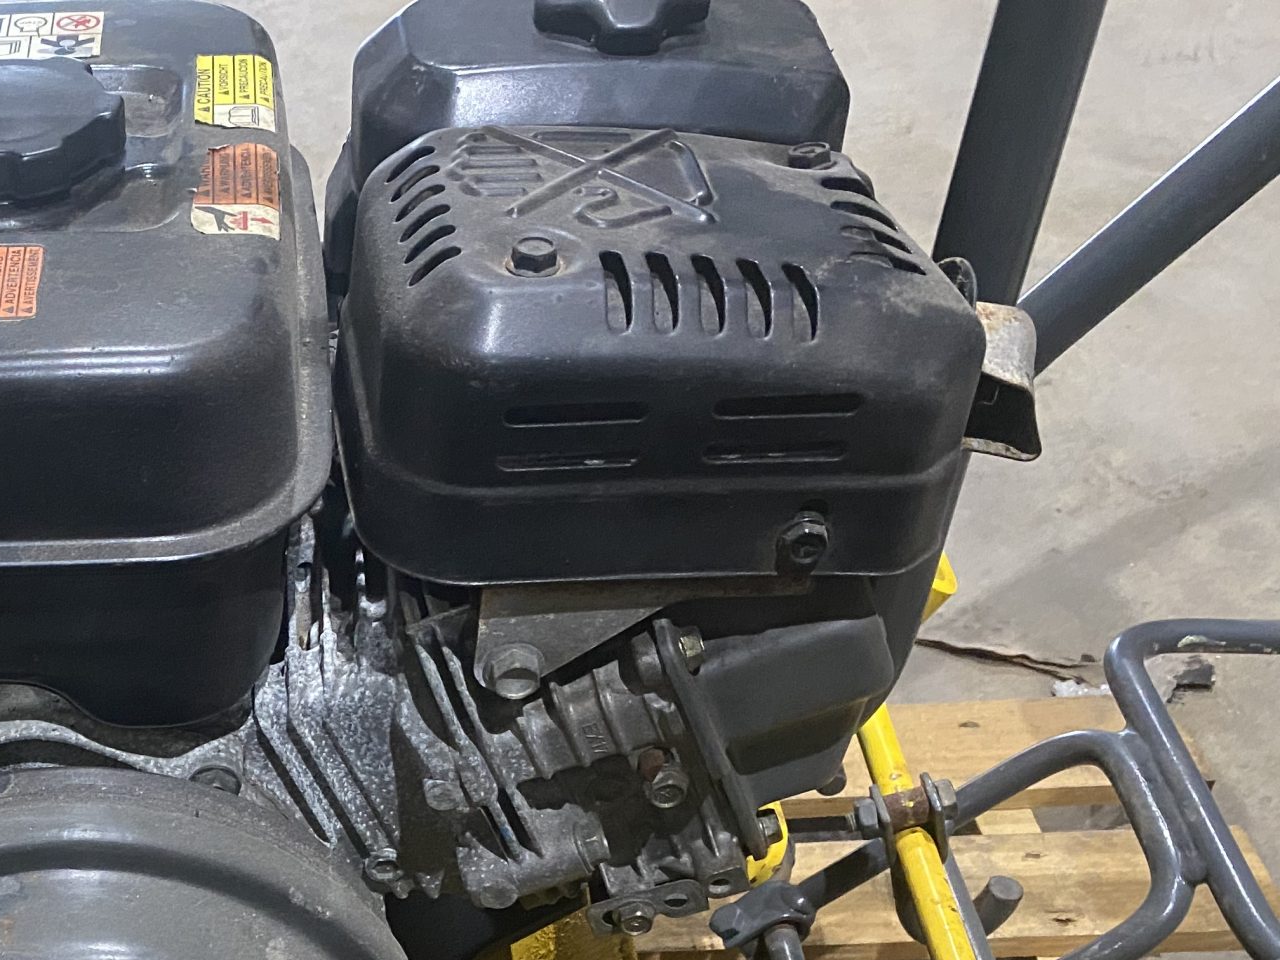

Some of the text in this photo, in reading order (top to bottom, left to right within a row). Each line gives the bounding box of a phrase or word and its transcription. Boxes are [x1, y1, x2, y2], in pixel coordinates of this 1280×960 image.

[197, 68, 211, 104] CAUTION
[219, 64, 228, 90] VORSICHT
[4, 249, 22, 305] ADVERTENCIA
[23, 248, 40, 305] AVERTISSEMENT
